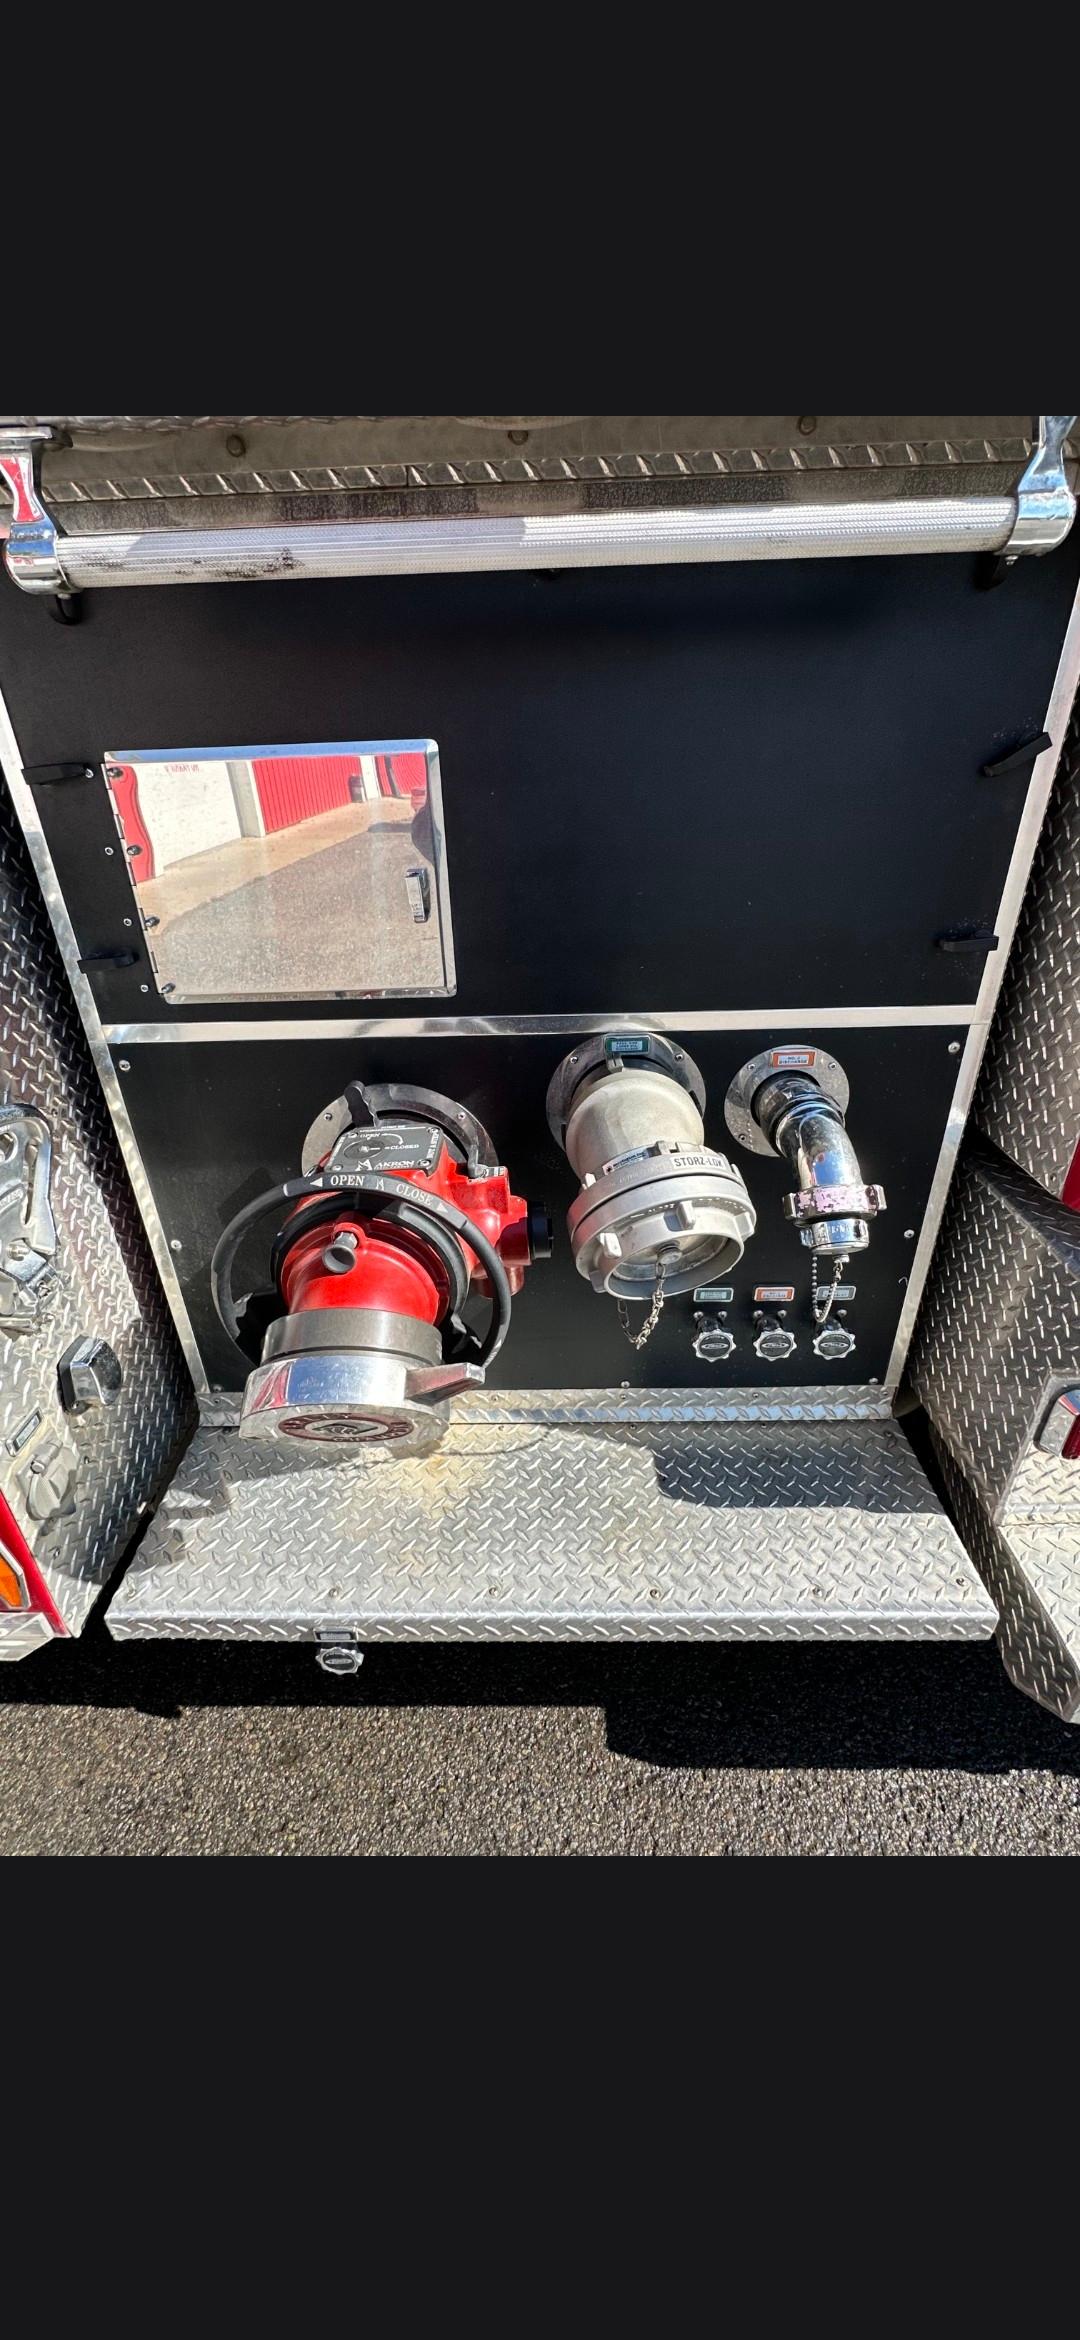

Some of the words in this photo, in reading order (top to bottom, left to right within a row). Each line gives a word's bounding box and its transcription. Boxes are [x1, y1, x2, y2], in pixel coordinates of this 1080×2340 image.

[373, 1160, 415, 1169] AKRON
[330, 1174, 365, 1187] OPEN
[395, 1183, 433, 1207] CLOSE
